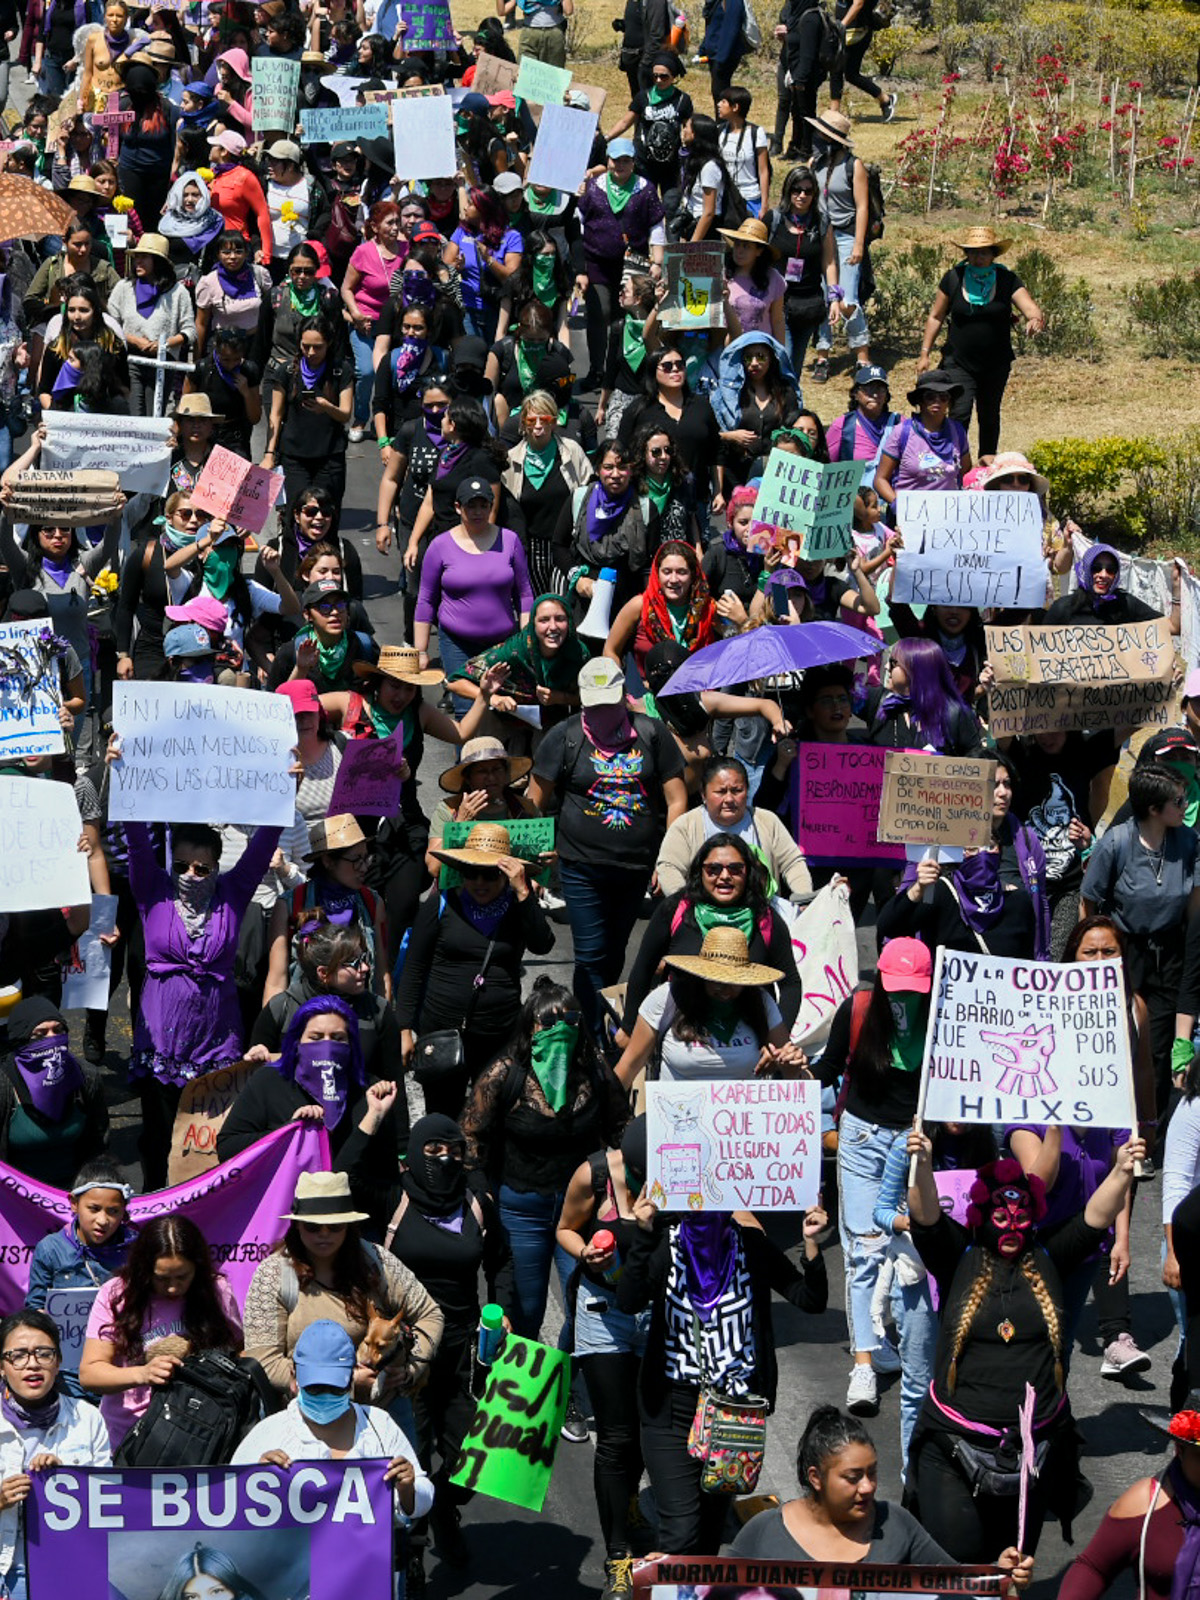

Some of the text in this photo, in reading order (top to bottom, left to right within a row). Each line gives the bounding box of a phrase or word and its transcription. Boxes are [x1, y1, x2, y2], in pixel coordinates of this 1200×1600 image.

[774, 460, 857, 491] NUESTRA
[779, 485, 854, 512] LUCHA ES
[904, 494, 1036, 526] LA PERIFERIA
[761, 506, 796, 531] POR
[953, 553, 994, 571] PORQUE
[1065, 688, 1079, 707] Y
[174, 698, 216, 721] UNA
[1072, 710, 1111, 729] NEZA
[805, 751, 827, 770] SI
[899, 756, 981, 778] SI TE CANSA
[115, 765, 292, 795] VIVAS LAS QUEREMOS
[897, 775, 985, 795] QUE HABLEMOS
[9, 780, 38, 809] EL
[897, 787, 914, 799] DE
[896, 802, 942, 820] IMAGINA
[946, 808, 992, 823] SUFRIRLO
[1, 819, 30, 851] DE
[894, 818, 926, 831] CADA
[982, 965, 1120, 993] LA COYOTA
[975, 988, 998, 1006] LA
[1062, 1009, 1118, 1031] POBLA
[1076, 1030, 1118, 1055] POR
[1077, 1062, 1120, 1088] SUS
[190, 1096, 231, 1114] HAY
[960, 1094, 1095, 1123] HIJXS
[713, 1108, 817, 1138] QUE TODAS
[719, 1138, 809, 1161] LLEGUEN A
[715, 1162, 756, 1182] CASA
[766, 1161, 804, 1182] CON
[43, 1466, 376, 1532] SE BUSCA
[656, 1562, 1005, 1595] NORMA DIANEY GARCIA GARCIA
